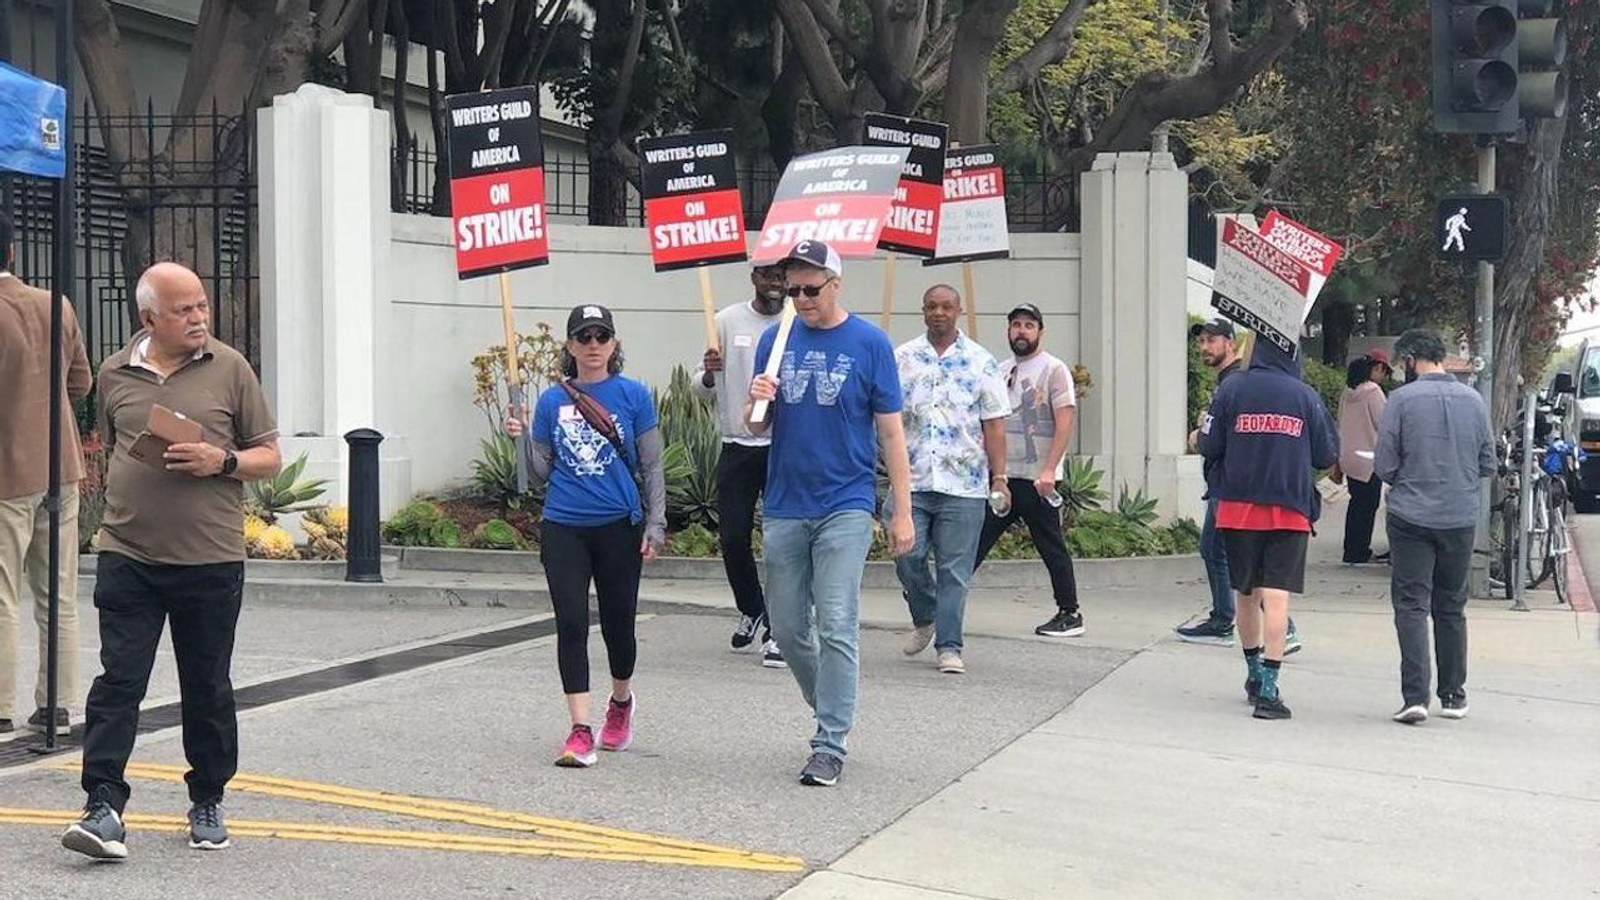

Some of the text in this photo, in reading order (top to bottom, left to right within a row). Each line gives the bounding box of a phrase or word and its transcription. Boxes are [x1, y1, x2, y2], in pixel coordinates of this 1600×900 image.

[452, 100, 531, 127] WRITERS GUILD
[488, 127, 500, 142] OF
[868, 126, 941, 149] WRITERS GUILD
[471, 145, 520, 168] AMERICA
[645, 143, 727, 163] WRITERS GUILD
[793, 153, 901, 171] WRITERS GUILD
[964, 153, 994, 166] GUILD
[683, 162, 695, 173] OF
[832, 168, 850, 178] OF
[489, 183, 510, 205] ON
[667, 174, 716, 192] AMERICA
[802, 179, 868, 194] AMERICA
[944, 172, 998, 199] RIKE!
[685, 200, 705, 217] ON
[815, 203, 841, 216] ON
[884, 204, 935, 235] RIKE!
[458, 203, 543, 252] STRIKE!
[654, 215, 740, 249] STRIKE!
[761, 217, 879, 247] STRIKE!
[1273, 217, 1332, 254] WRITERS
[797, 242, 811, 254] C
[1270, 227, 1311, 253] GUILD
[1264, 234, 1324, 271] AMERICA
[1218, 297, 1290, 352] STRIKE
[1234, 413, 1304, 437] JEOPARDY!
